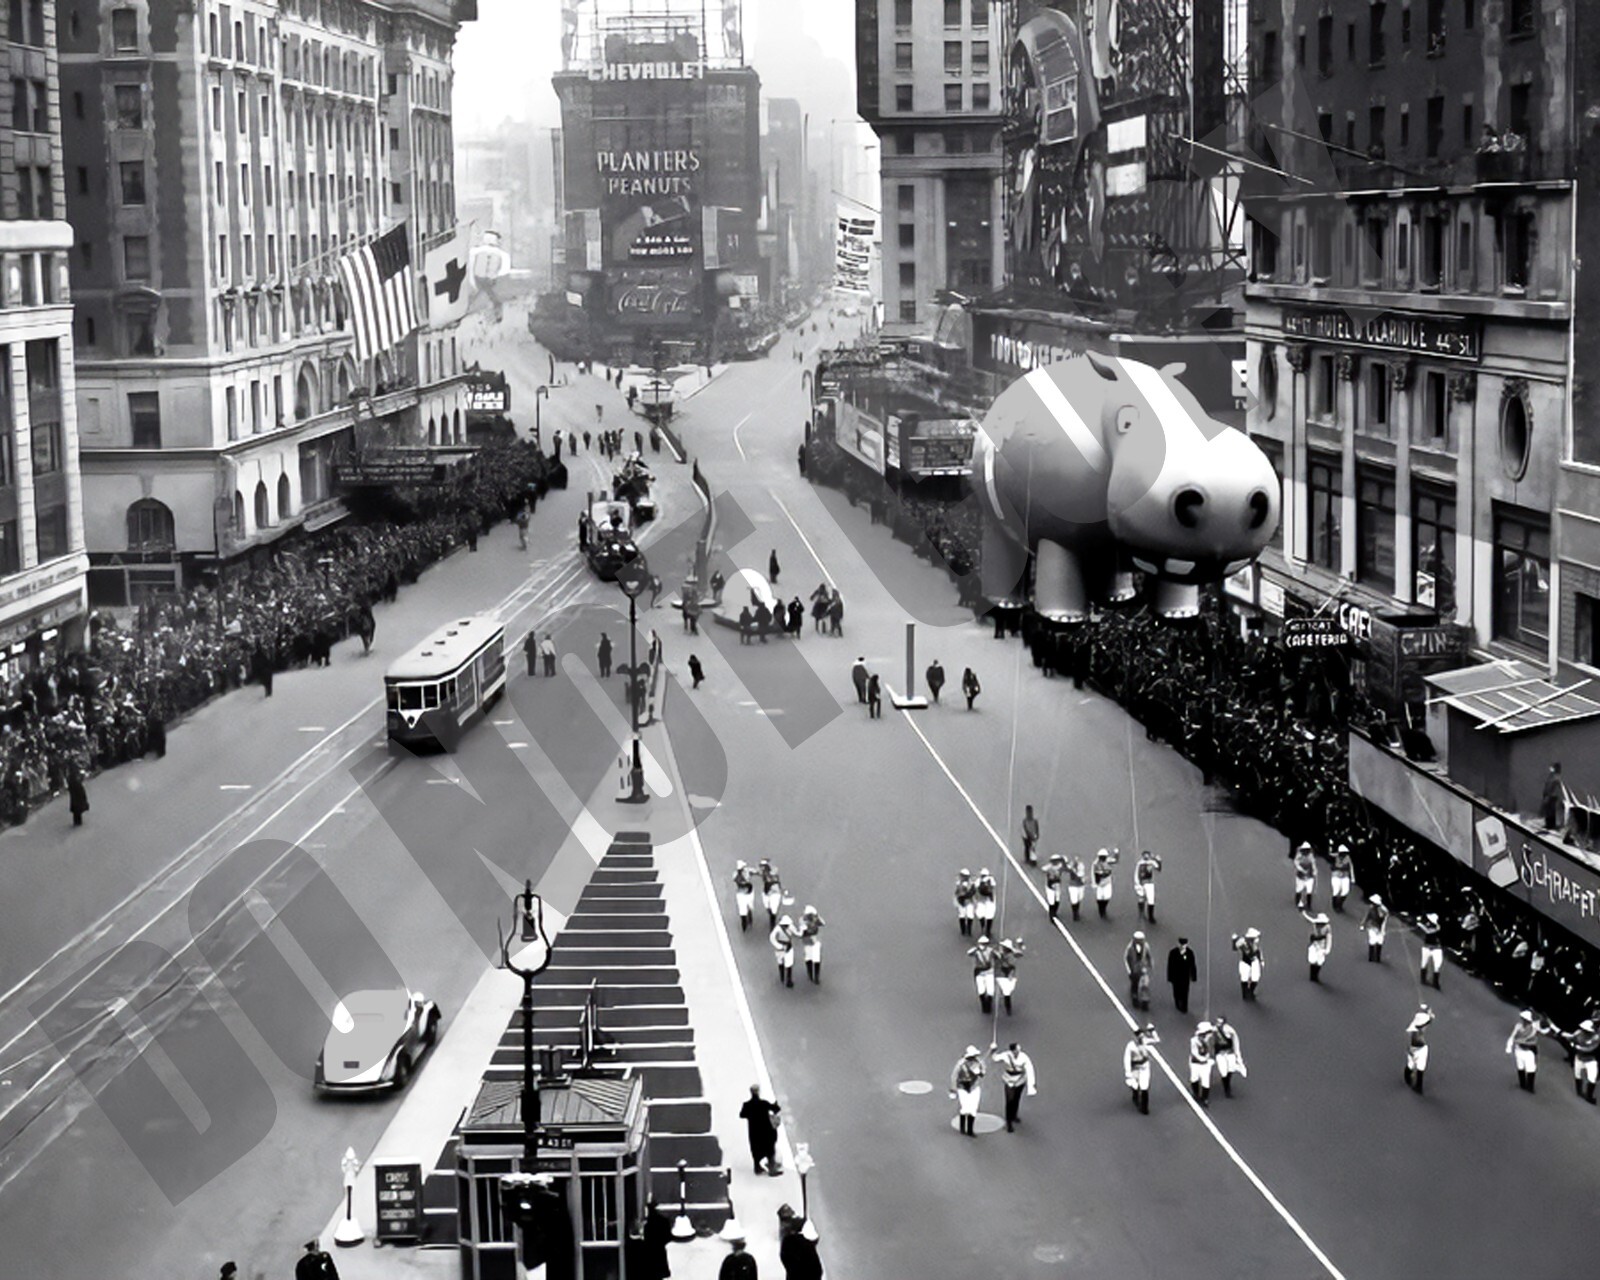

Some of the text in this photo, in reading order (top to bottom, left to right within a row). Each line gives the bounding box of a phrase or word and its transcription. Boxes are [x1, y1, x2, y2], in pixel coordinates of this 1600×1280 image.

[587, 61, 707, 81] CHEVROLET
[597, 151, 700, 172] PLANTERS
[608, 177, 691, 195] PEANUTS
[1317, 315, 1351, 338] HOTEL
[1366, 319, 1427, 347] CLARIDGE
[1286, 634, 1348, 648] CAFETERIA
[1521, 843, 1600, 922] SCHRAFFT
